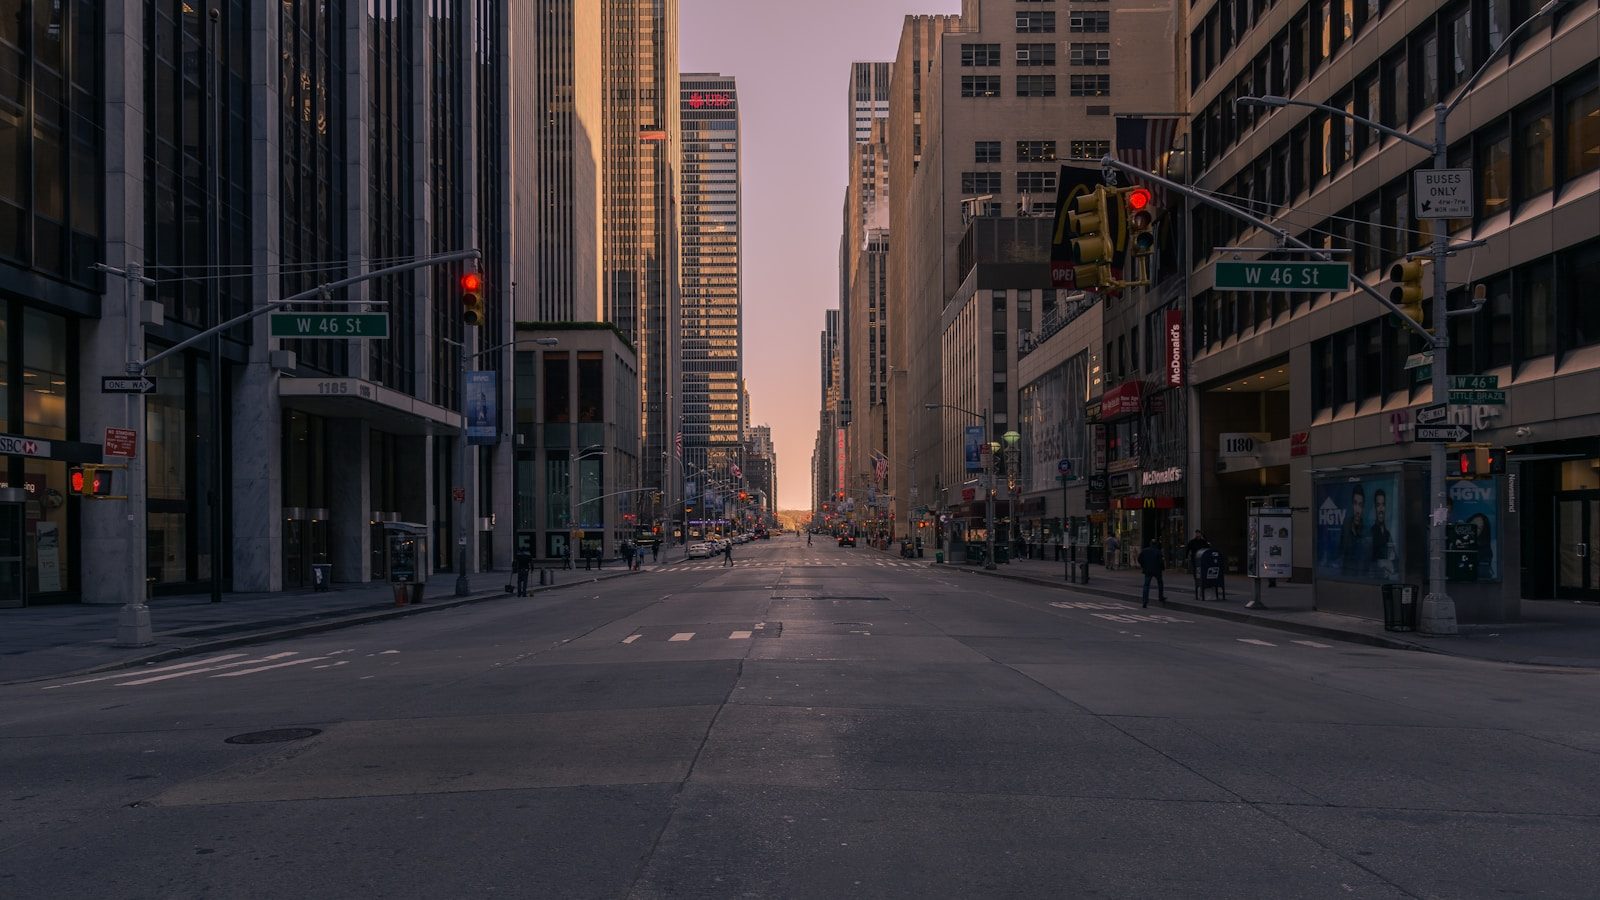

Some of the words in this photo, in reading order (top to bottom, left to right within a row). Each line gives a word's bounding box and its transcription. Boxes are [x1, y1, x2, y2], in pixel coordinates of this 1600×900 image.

[705, 94, 730, 106] UBS
[1426, 174, 1461, 184] BUSES
[1430, 187, 1457, 196] ONLY
[1245, 267, 1262, 283] W
[1270, 268, 1292, 284] 46
[1301, 268, 1319, 285] St
[297, 318, 311, 332] W
[319, 318, 338, 333] 46
[346, 318, 361, 333] St
[1171, 324, 1180, 383] McDonald's
[109, 381, 125, 389] ONE
[132, 381, 148, 389] WAY
[319, 382, 347, 393] 1185
[1457, 378, 1466, 387] W
[1471, 378, 1486, 388] 46
[1449, 392, 1475, 400] LITTLE
[1477, 392, 1505, 400] BRAZIL
[1226, 438, 1253, 452] 1180
[1142, 466, 1181, 485] McDonald's
[1450, 487, 1492, 501] HGTV
[1319, 508, 1346, 525] HGTV
